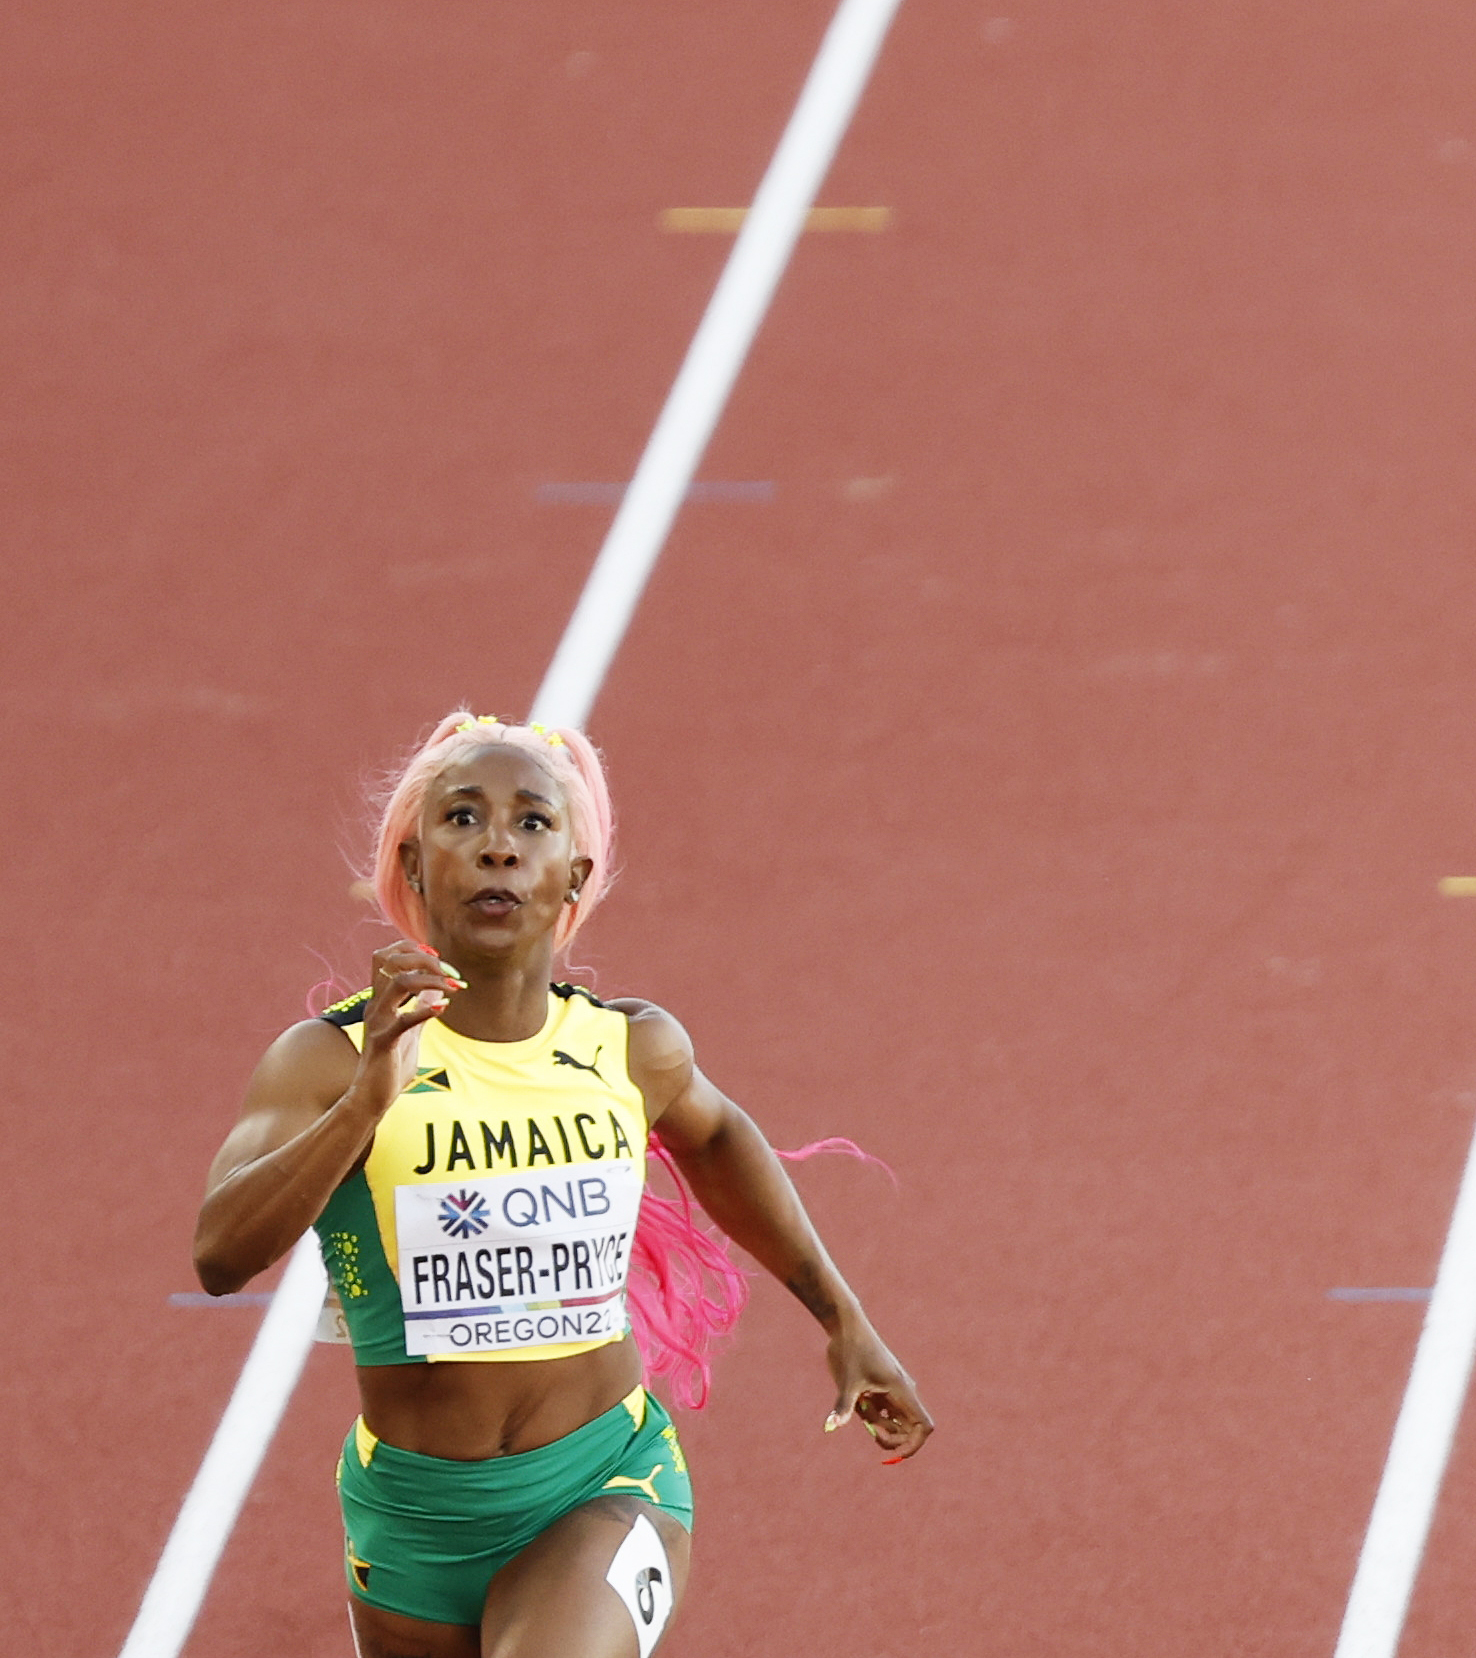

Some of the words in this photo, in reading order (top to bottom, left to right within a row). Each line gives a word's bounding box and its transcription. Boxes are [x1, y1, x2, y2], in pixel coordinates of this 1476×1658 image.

[413, 1110, 633, 1175] JAMAICA
[502, 1178, 611, 1227] QNB
[413, 1232, 627, 1305] FRASER-PRYCE
